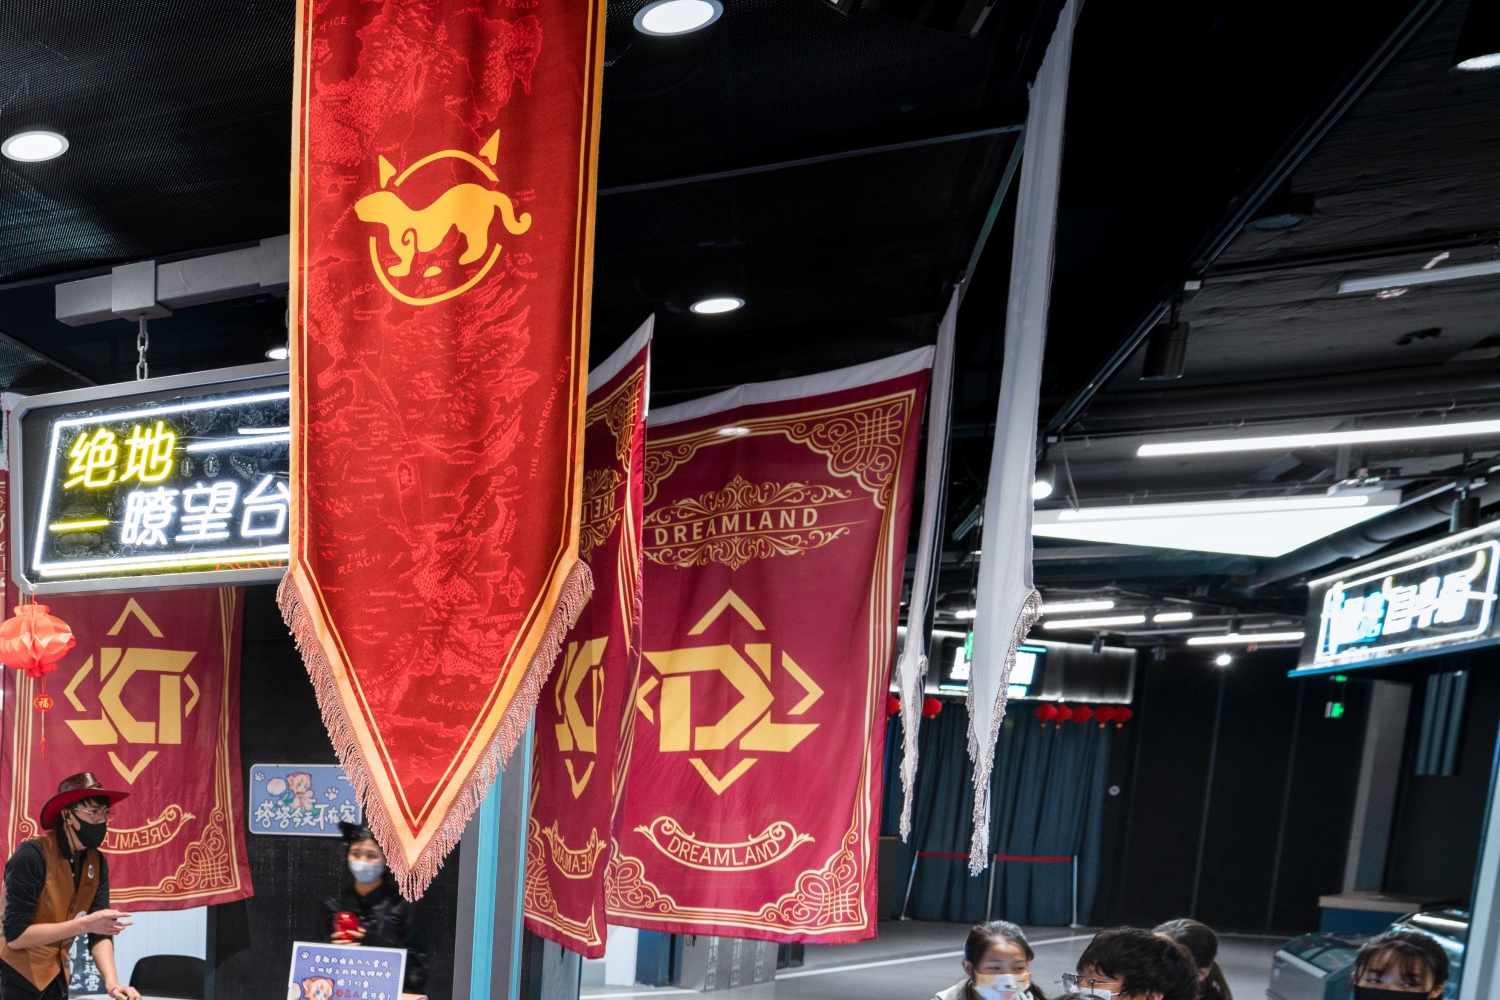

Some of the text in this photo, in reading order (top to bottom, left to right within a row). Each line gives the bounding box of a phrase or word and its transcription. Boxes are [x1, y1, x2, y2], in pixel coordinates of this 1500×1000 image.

[330, 16, 347, 26] ICE
[351, 283, 378, 299] NECK
[450, 368, 470, 386] VALE
[479, 342, 509, 364] ARRYN
[320, 403, 336, 417] BAY
[529, 354, 572, 480] THE NARROW SEA
[63, 420, 176, 488] 绝地
[121, 474, 290, 546] 瞭望台
[655, 508, 818, 546] DREAMLAND
[338, 553, 381, 575] REACH
[347, 548, 368, 561] THE
[477, 611, 525, 626] SHIPBREAKER
[363, 656, 408, 687] MARCHES
[37, 697, 50, 709] 福
[427, 692, 446, 707] SEA
[457, 701, 484, 711] DORN
[254, 800, 356, 831] 塔塔今天不在家
[667, 834, 780, 867] DREAMLAND
